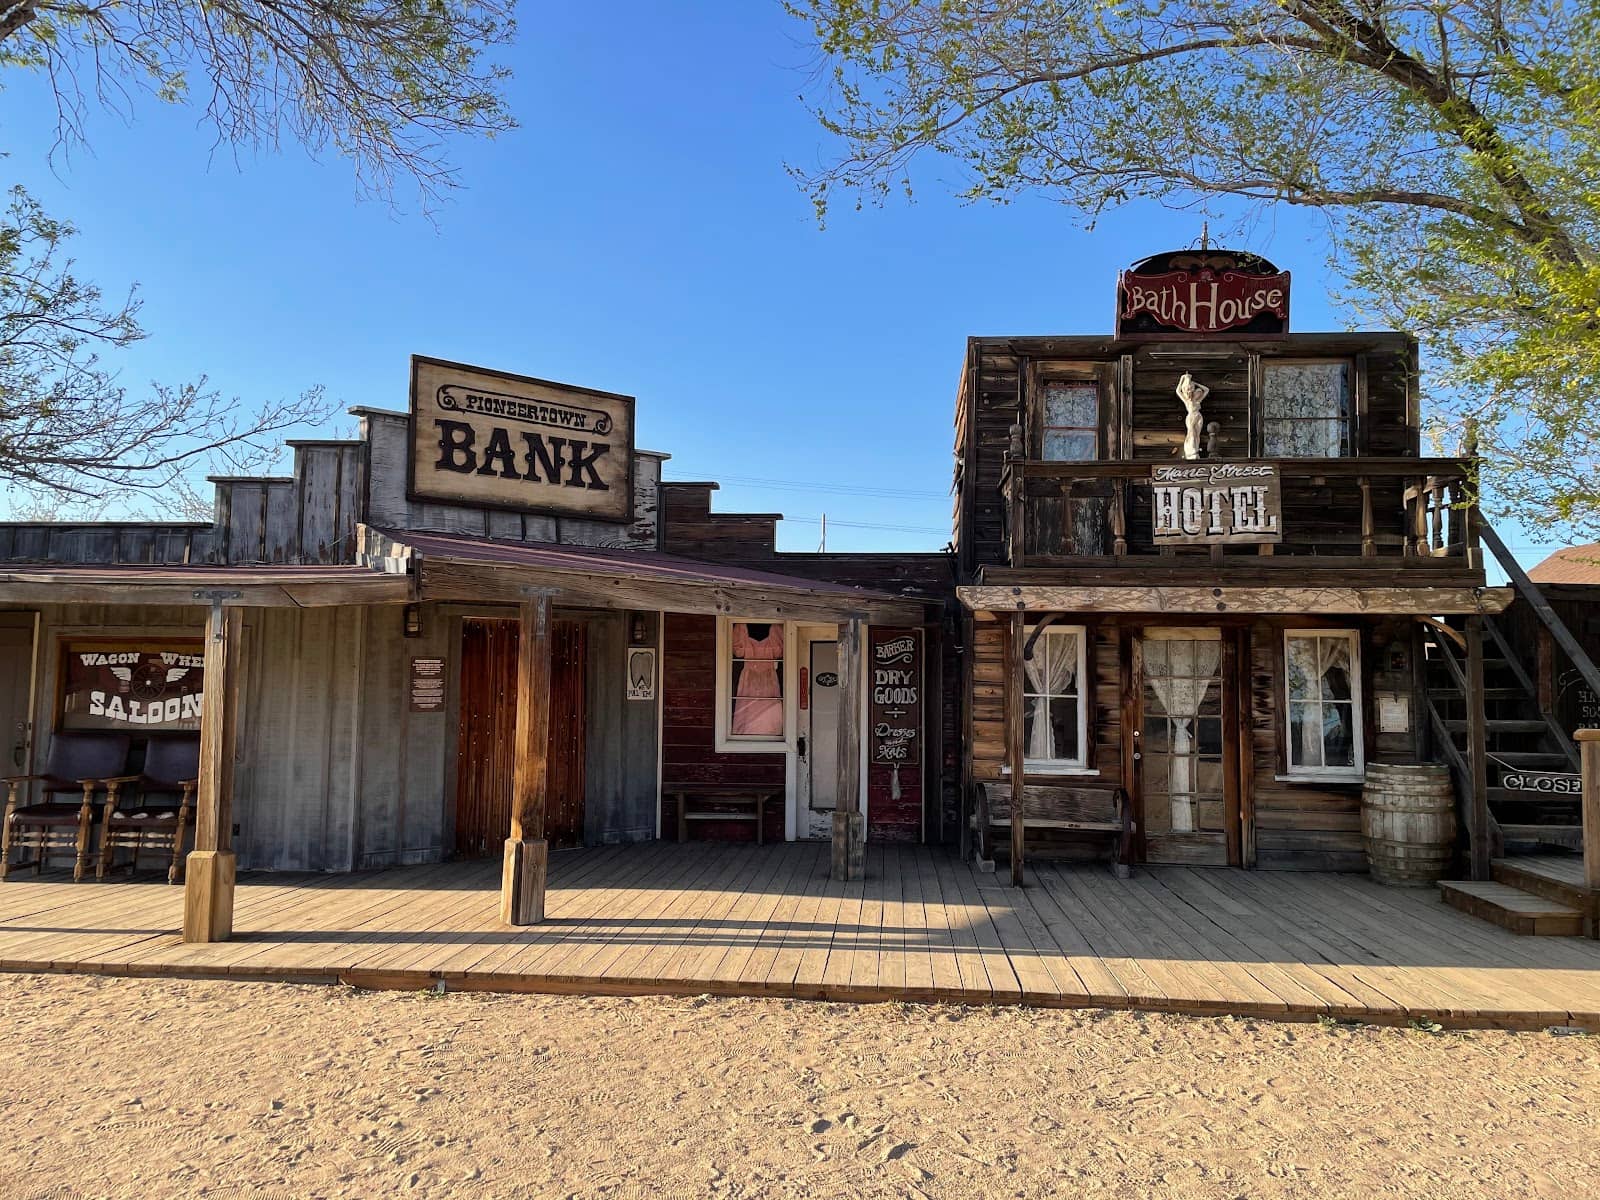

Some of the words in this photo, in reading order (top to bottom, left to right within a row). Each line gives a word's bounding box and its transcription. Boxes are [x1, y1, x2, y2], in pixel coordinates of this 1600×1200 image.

[465, 394, 587, 428] PIONEERTOWN
[434, 418, 610, 491] BANK
[1154, 465, 1209, 481] Mane
[1208, 463, 1275, 485] Street
[1153, 485, 1278, 537] HOTEL
[80, 653, 140, 666] WAGON
[875, 640, 914, 659] BARBER
[874, 669, 914, 685] DRY
[874, 687, 917, 704] GOODS
[89, 690, 205, 724] SALOON
[874, 722, 916, 738] Dresses
[1503, 774, 1583, 795] CLOSE
